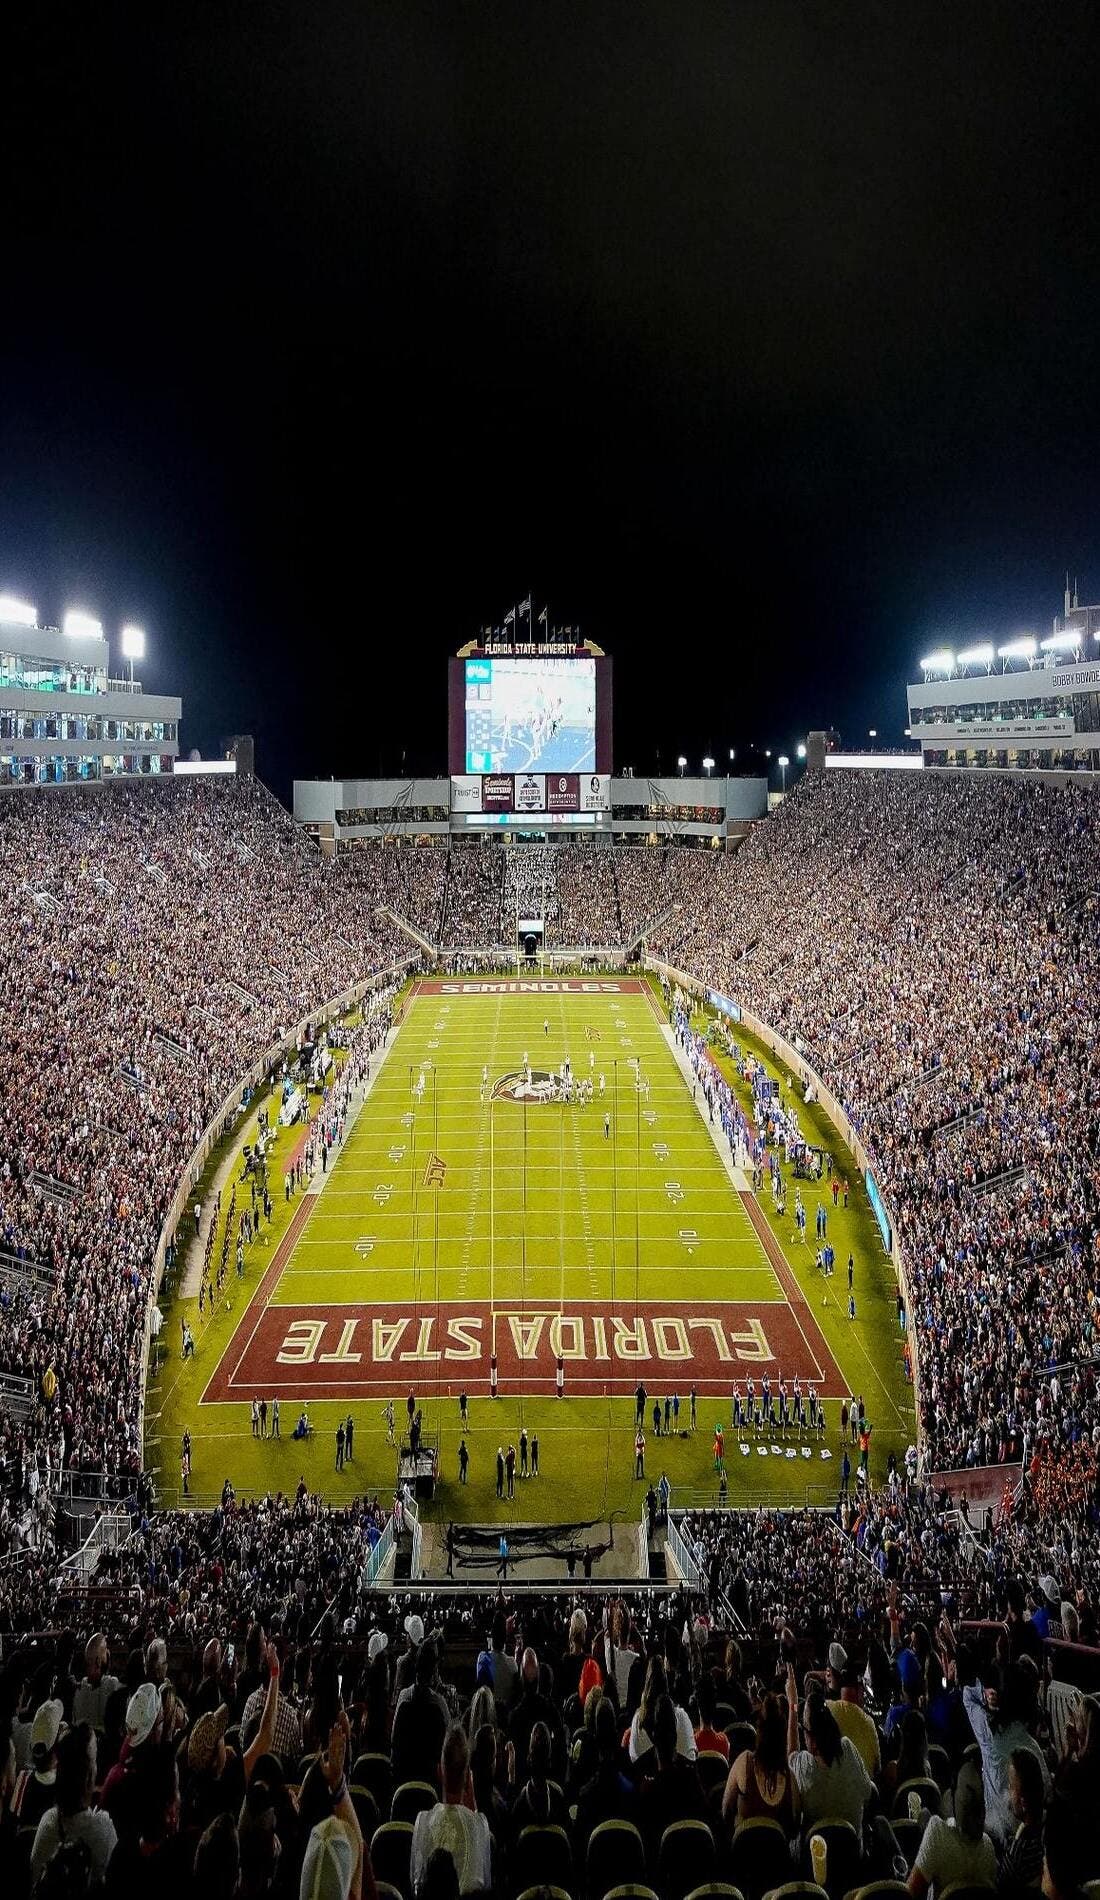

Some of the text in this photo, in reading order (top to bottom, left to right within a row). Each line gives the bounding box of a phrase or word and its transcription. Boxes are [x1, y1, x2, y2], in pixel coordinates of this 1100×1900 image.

[485, 643, 577, 654] FLORIDA STATE UNIVERSITY
[1052, 673, 1075, 687] BOBBY
[441, 983, 621, 994] SEMINOLES
[373, 1184, 394, 1200] 20
[664, 1182, 686, 1199] 20
[354, 1236, 378, 1251] 10
[678, 1230, 701, 1245] 10
[275, 1316, 777, 1364] FLORIDA STATE
